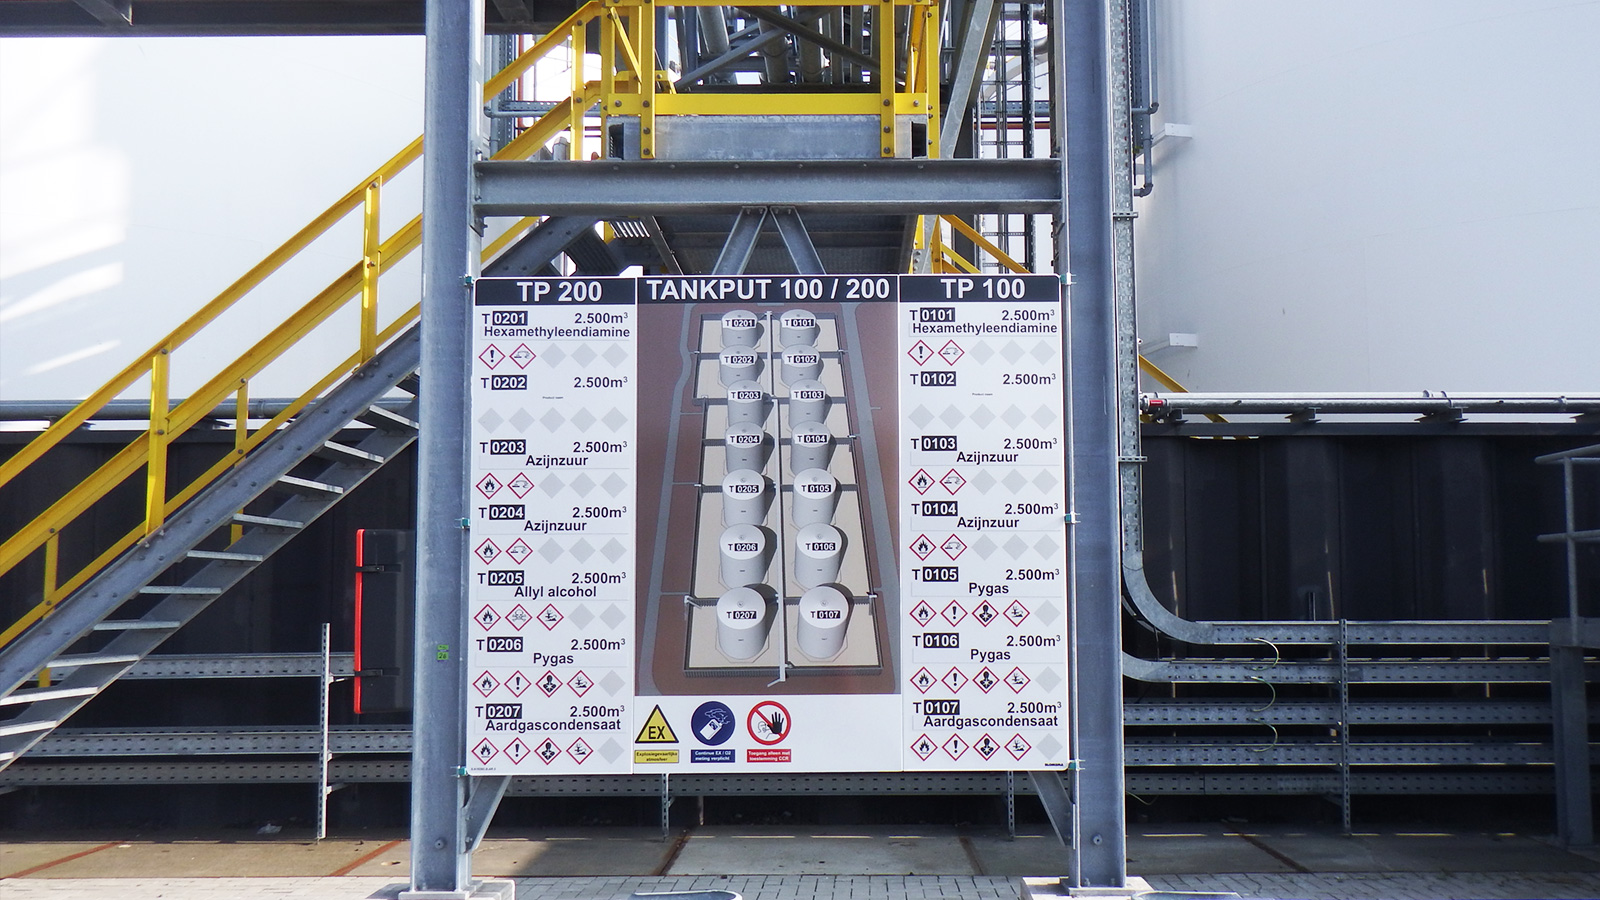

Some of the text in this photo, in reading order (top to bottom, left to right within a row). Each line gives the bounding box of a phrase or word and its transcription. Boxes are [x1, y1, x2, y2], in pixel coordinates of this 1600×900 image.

[517, 282, 601, 301] TP 200
[646, 278, 889, 300] TANKPUT 100 / 200
[941, 279, 1025, 298] TP 100
[481, 313, 491, 325] T
[493, 312, 525, 325] 0201
[909, 309, 918, 321] T
[921, 308, 953, 321] 0101
[733, 319, 753, 327] 0201
[792, 319, 812, 327] 0101
[912, 322, 1058, 336] Hexamethyleendiamine
[484, 324, 631, 340] Hexamethyleendiamine
[733, 356, 753, 364] 0202
[795, 355, 816, 363] 0102
[480, 377, 490, 389] T
[493, 376, 526, 389] 0202
[909, 373, 919, 385] T
[922, 372, 955, 385] 0102
[738, 391, 760, 399] 0203
[738, 435, 759, 443] 0204
[805, 435, 826, 443] 0104
[910, 438, 920, 450] T
[923, 437, 956, 450] 0103
[479, 441, 489, 454] T
[491, 441, 525, 454] 0203
[525, 454, 589, 470] Azijnzuur
[956, 451, 1019, 465] Azijnzuur
[737, 485, 758, 493] 0205
[478, 507, 488, 519] T
[490, 506, 524, 519] 0204
[910, 503, 921, 515] T
[923, 502, 957, 515] 0104
[523, 518, 588, 534] Azijnzuur
[956, 516, 1020, 530] Azijnzuur
[736, 543, 757, 551] 0206
[477, 572, 487, 585] T
[489, 572, 523, 585] 0205
[911, 568, 921, 581] T
[924, 568, 958, 581] 0105
[514, 585, 597, 601] Allyl alcohol
[968, 582, 1009, 597] Pygas
[734, 611, 755, 619] 0207
[475, 639, 486, 651] T
[488, 638, 522, 651] 0206
[911, 635, 922, 647] T
[924, 634, 958, 647] 0106
[533, 652, 574, 667] Pygas
[970, 648, 1011, 663] Pygas
[474, 705, 484, 718] T
[487, 705, 521, 718] 0207
[912, 701, 922, 714] T
[925, 701, 959, 714] 0107
[485, 717, 621, 734] Aardgascondensaat
[923, 714, 1058, 730] Aardgascondensaat
[648, 726, 666, 740] EX
